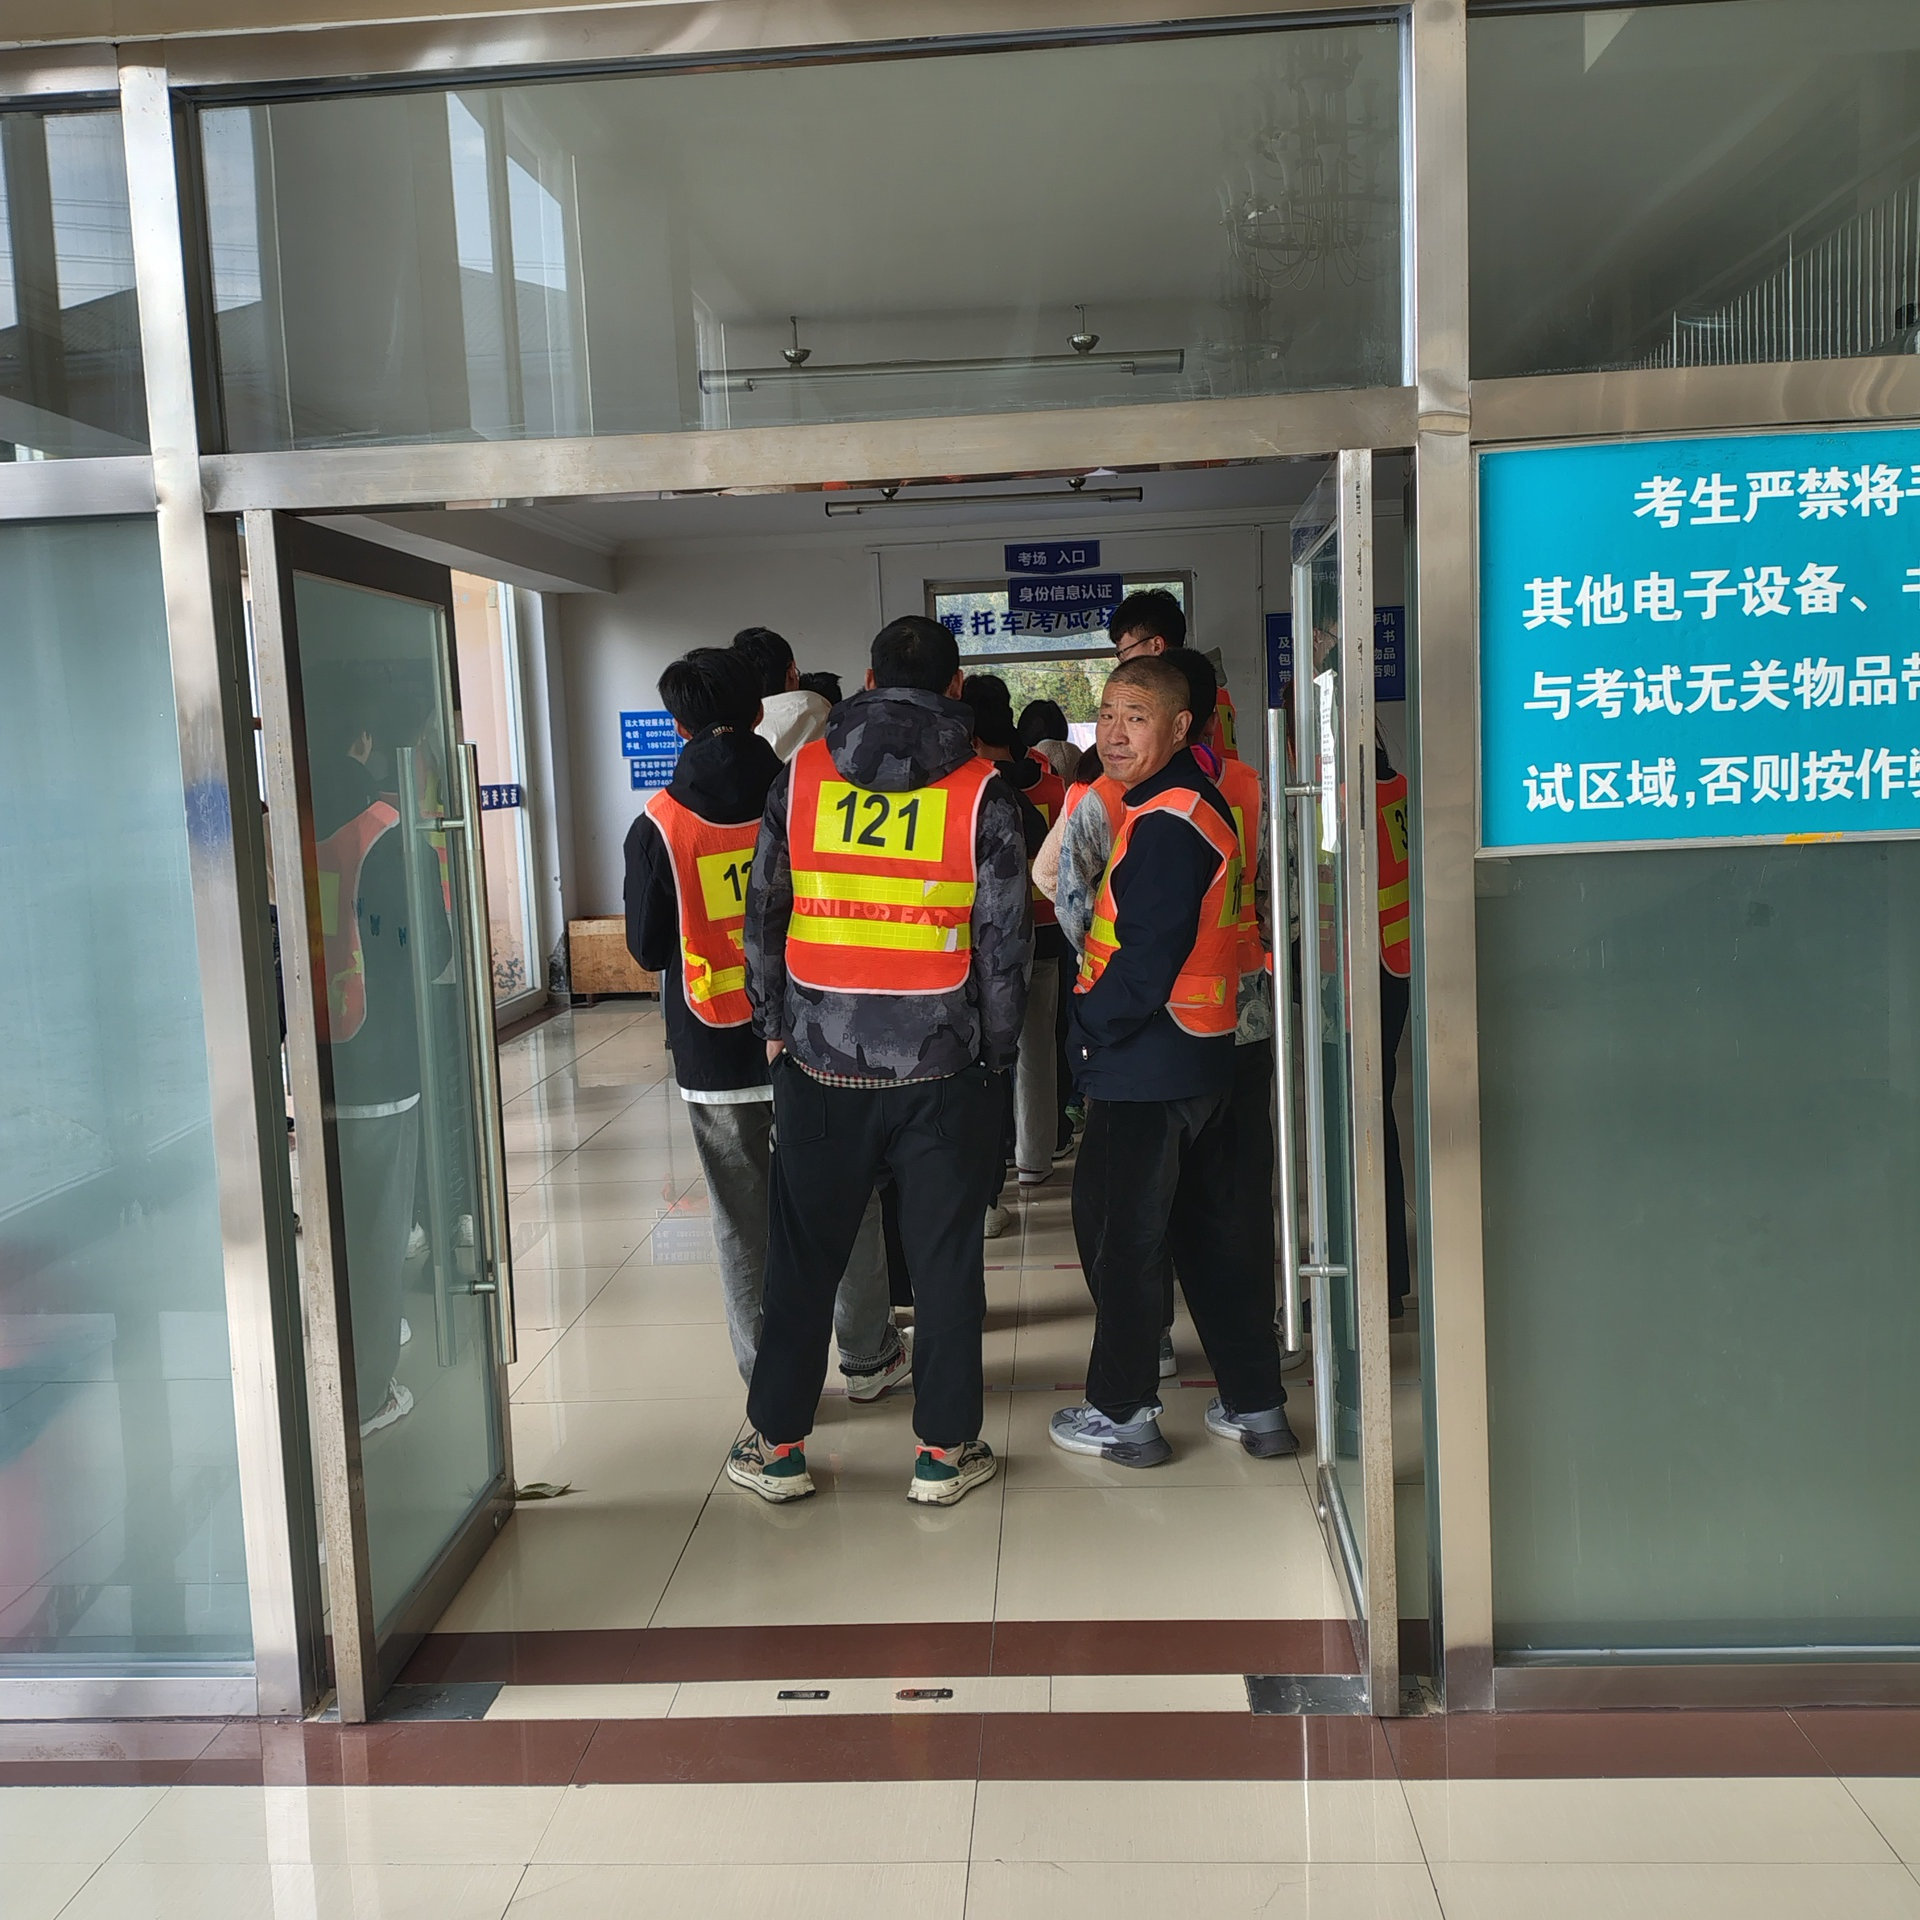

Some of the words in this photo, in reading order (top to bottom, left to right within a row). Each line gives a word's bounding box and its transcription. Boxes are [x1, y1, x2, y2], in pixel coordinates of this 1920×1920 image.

[1018, 552, 1047, 567] 考场
[1057, 550, 1085, 564] 入口
[1019, 584, 1112, 603] 身份信息认证
[1382, 630, 1396, 643] 书
[836, 790, 920, 852] 121
